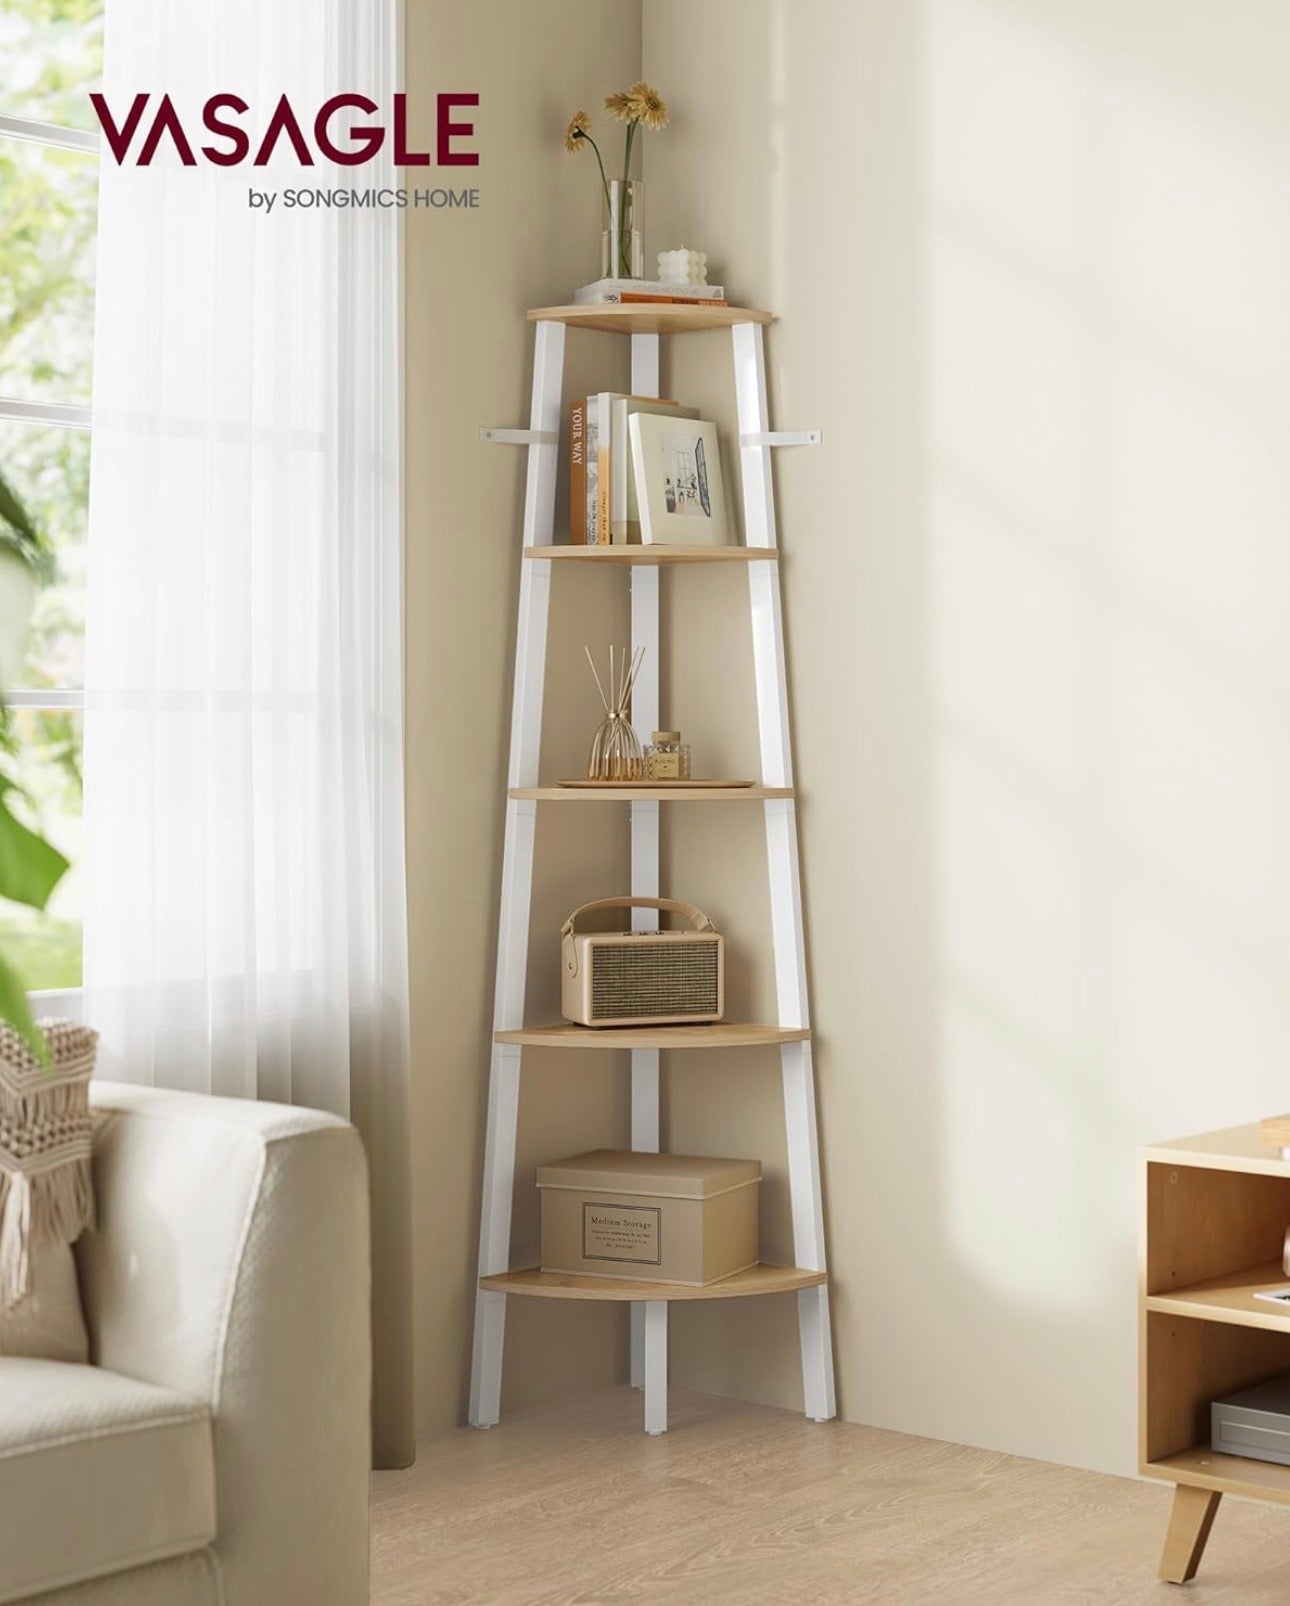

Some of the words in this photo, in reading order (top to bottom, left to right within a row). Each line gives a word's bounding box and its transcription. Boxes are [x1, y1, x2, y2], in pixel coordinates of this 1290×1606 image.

[572, 407, 583, 439] YOUR
[572, 442, 583, 465] WAY
[591, 1216, 621, 1226] Medium
[623, 1219, 652, 1229] Storage
